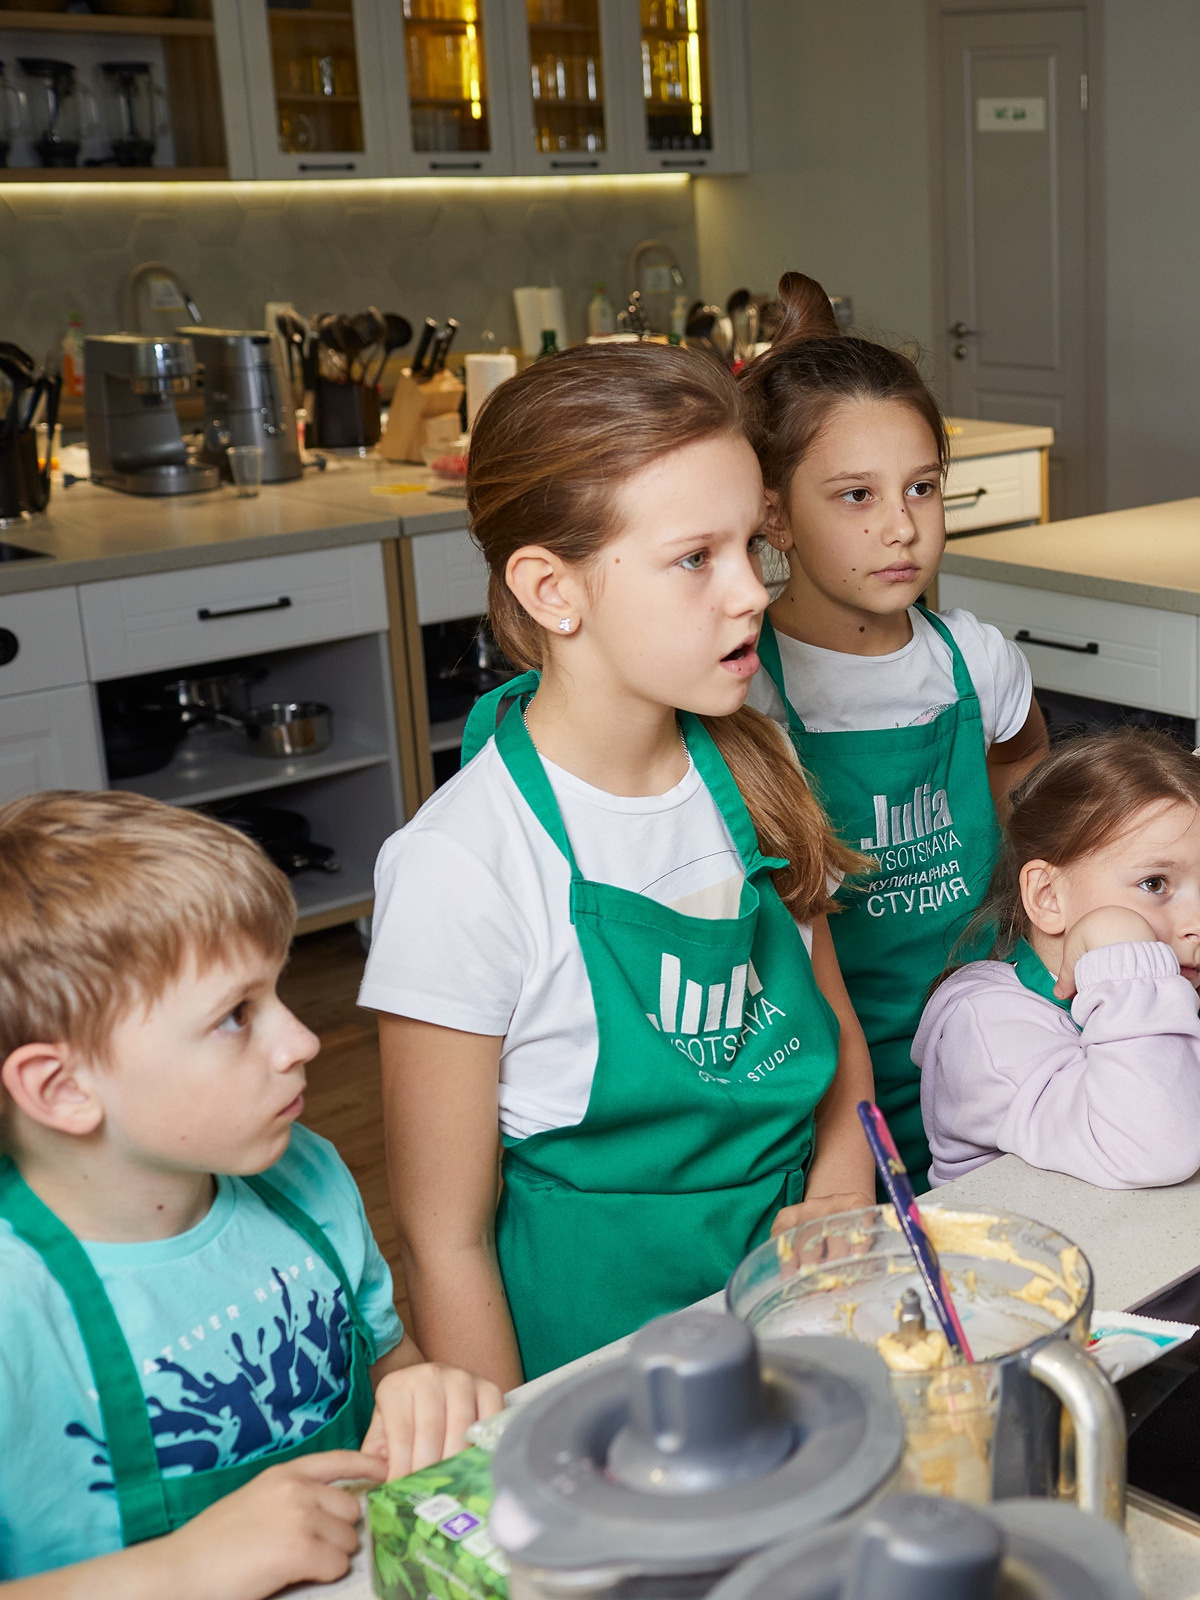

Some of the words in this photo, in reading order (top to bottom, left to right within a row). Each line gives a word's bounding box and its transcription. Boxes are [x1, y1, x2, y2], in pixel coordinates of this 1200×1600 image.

[861, 783, 953, 850] Julia
[866, 829, 962, 874] YSOTSKAYA
[867, 876, 970, 918] СТУДИЯ
[868, 860, 960, 893] КУЛИНАРНАЯ
[747, 1037, 800, 1082] STUDIO
[254, 1256, 316, 1303] HAPPE
